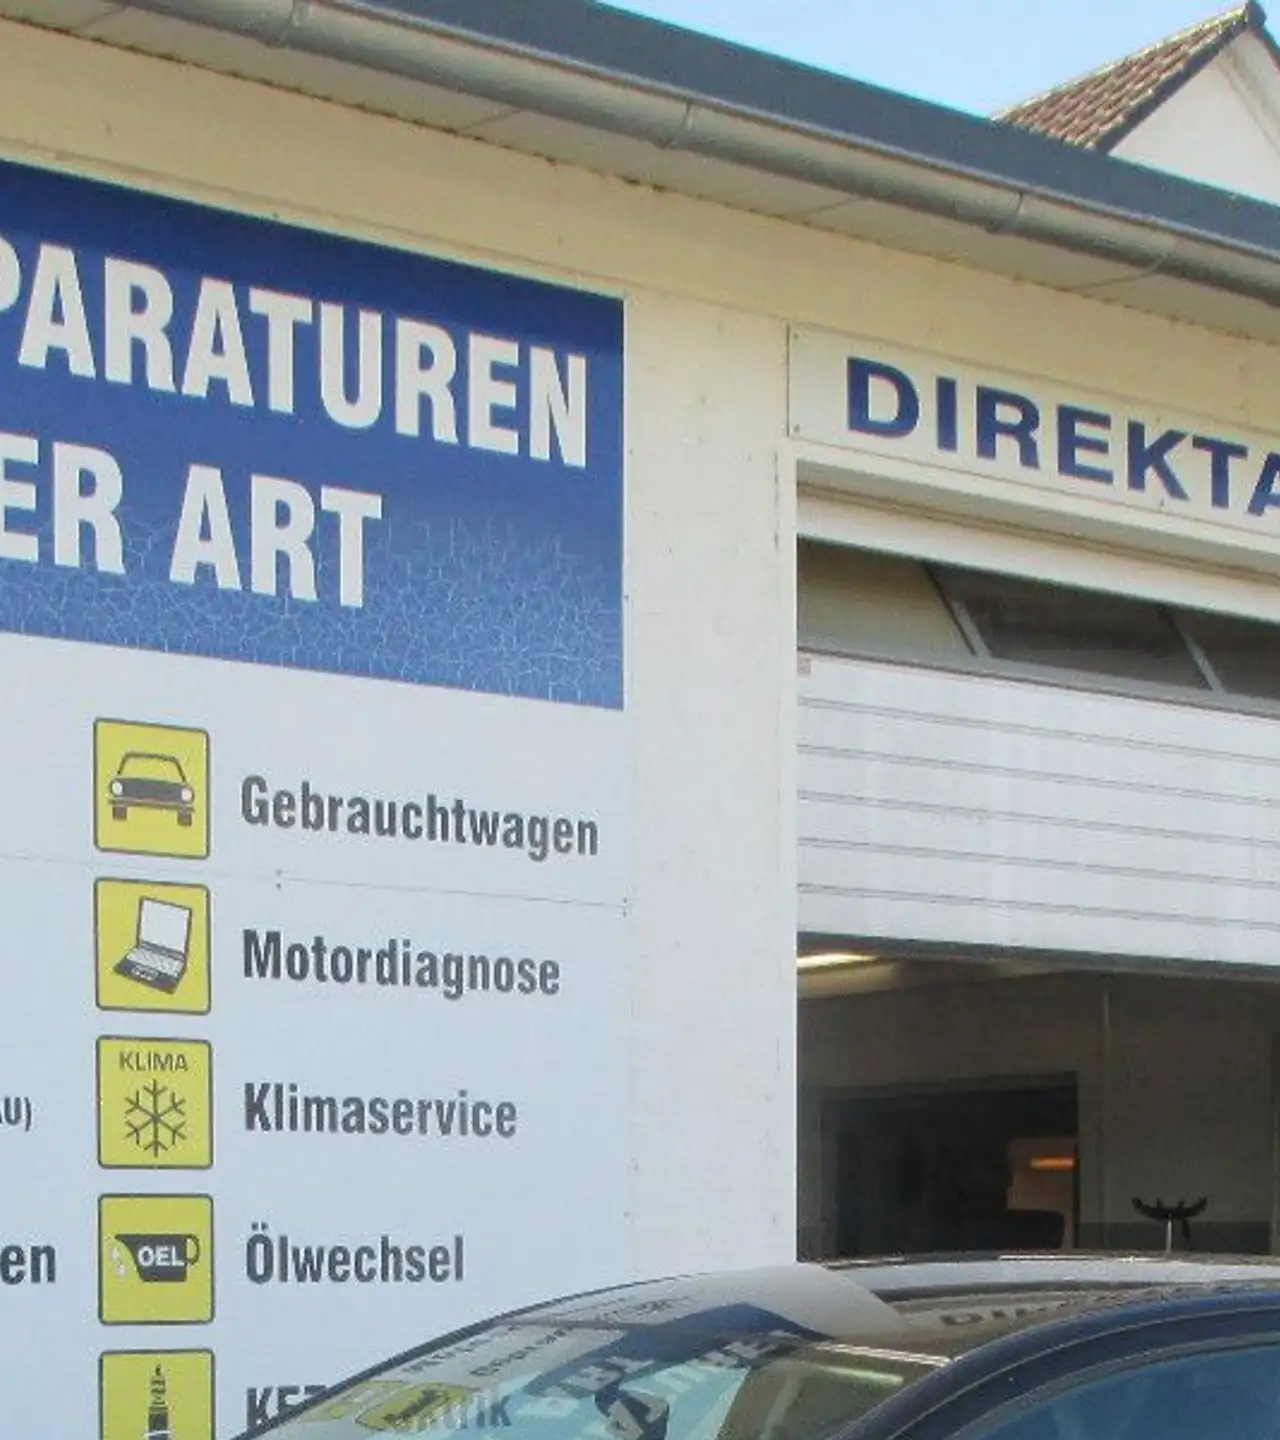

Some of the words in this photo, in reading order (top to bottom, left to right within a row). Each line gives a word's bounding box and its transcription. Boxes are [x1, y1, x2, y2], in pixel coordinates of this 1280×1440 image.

[168, 464, 383, 608] ART
[240, 774, 599, 862] Gebrauchtwagen
[242, 928, 561, 1001] Motordiagnose
[120, 1050, 189, 1073] KLIMA
[243, 1082, 518, 1139] Klimaservice
[138, 1244, 186, 1268] OEL
[245, 1222, 465, 1285] Ölwechsel
